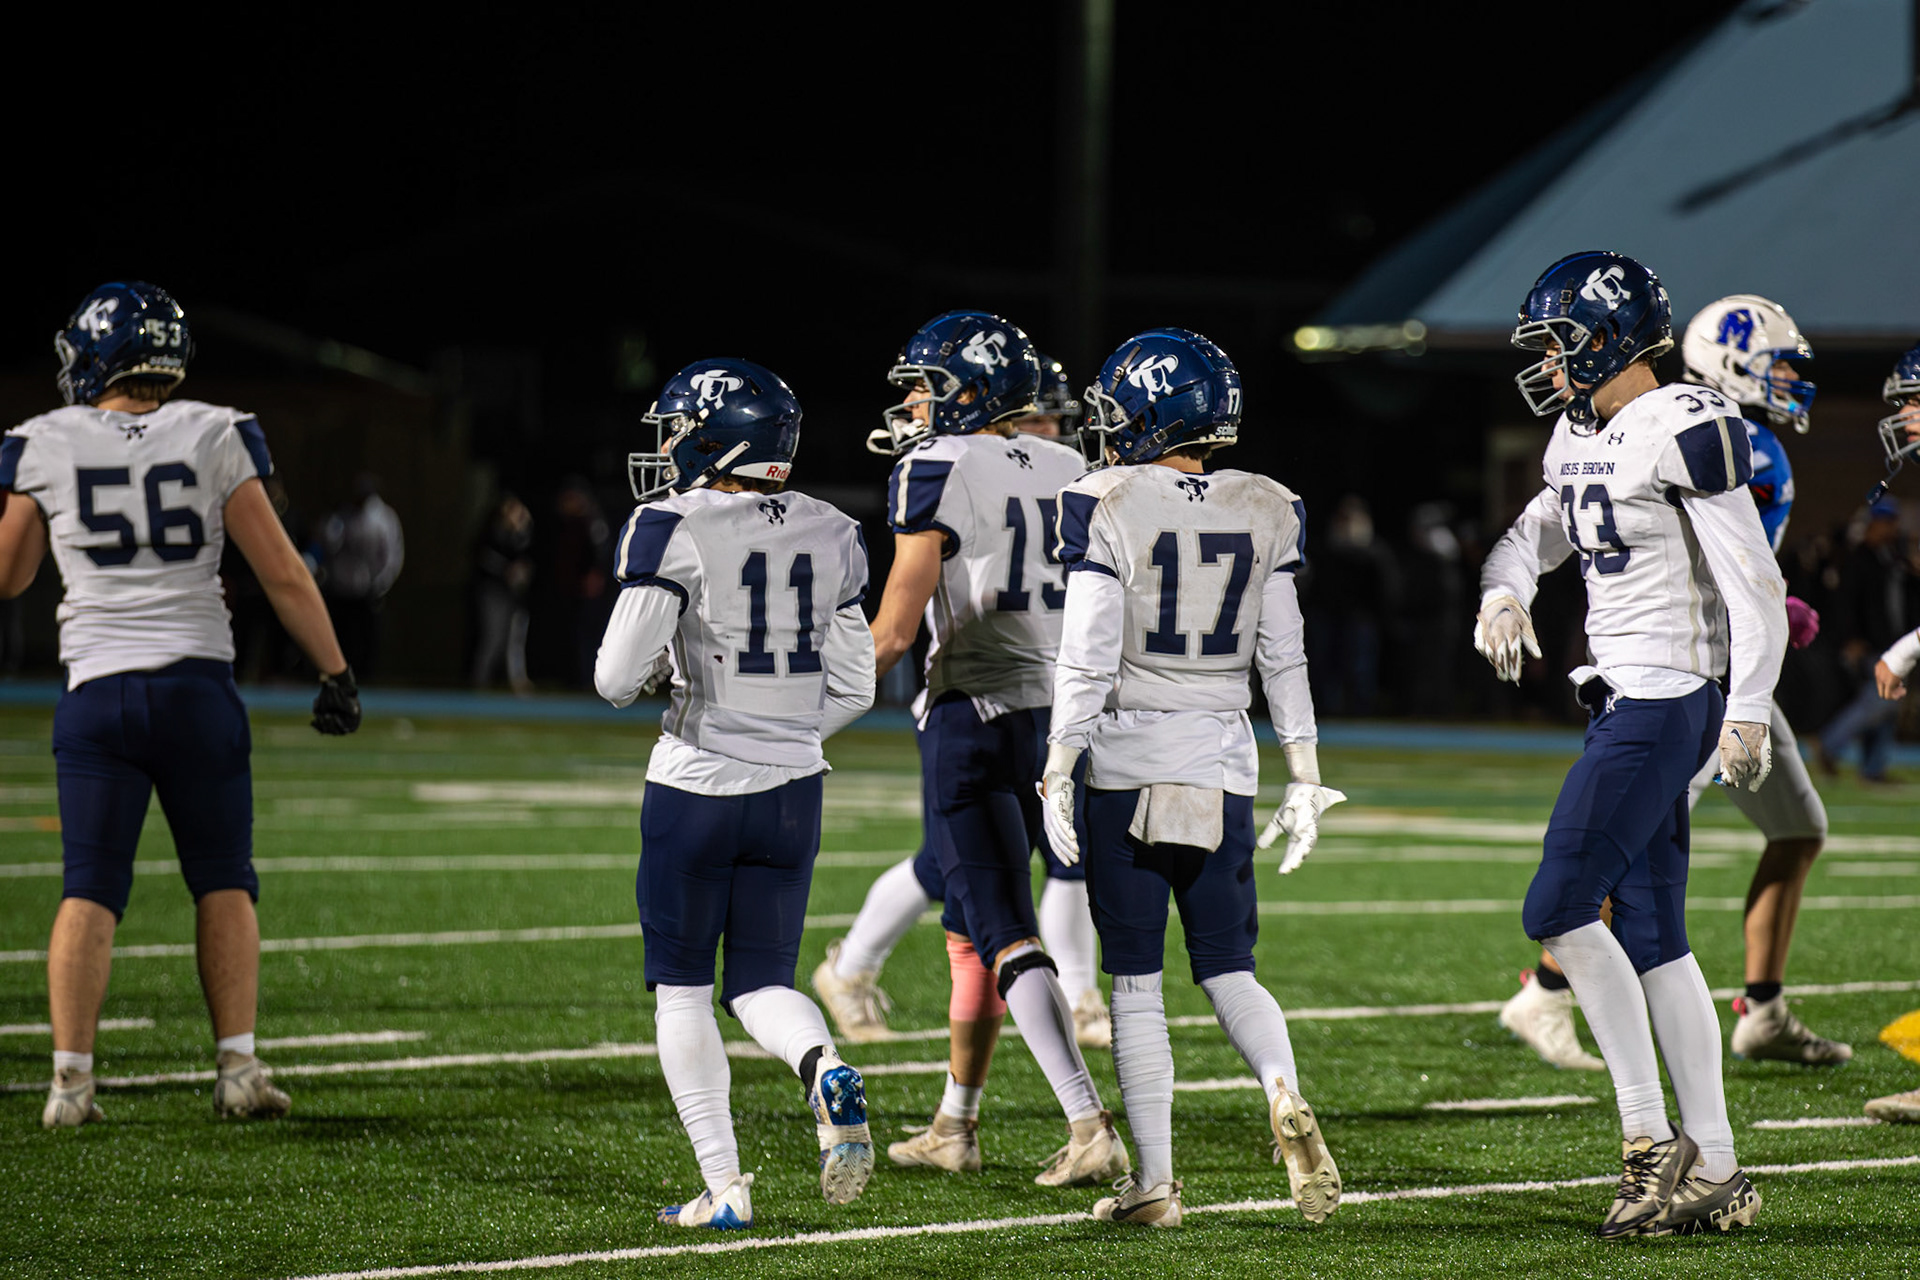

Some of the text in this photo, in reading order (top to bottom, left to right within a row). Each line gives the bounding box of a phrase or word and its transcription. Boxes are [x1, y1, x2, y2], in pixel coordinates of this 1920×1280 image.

[1227, 387, 1241, 415] 17
[1674, 390, 1725, 413] 33
[1582, 462, 1615, 475] BROWN
[77, 463, 205, 567] 56
[1560, 484, 1630, 576] 33
[736, 549, 823, 677] 11
[1143, 529, 1255, 658] 17
